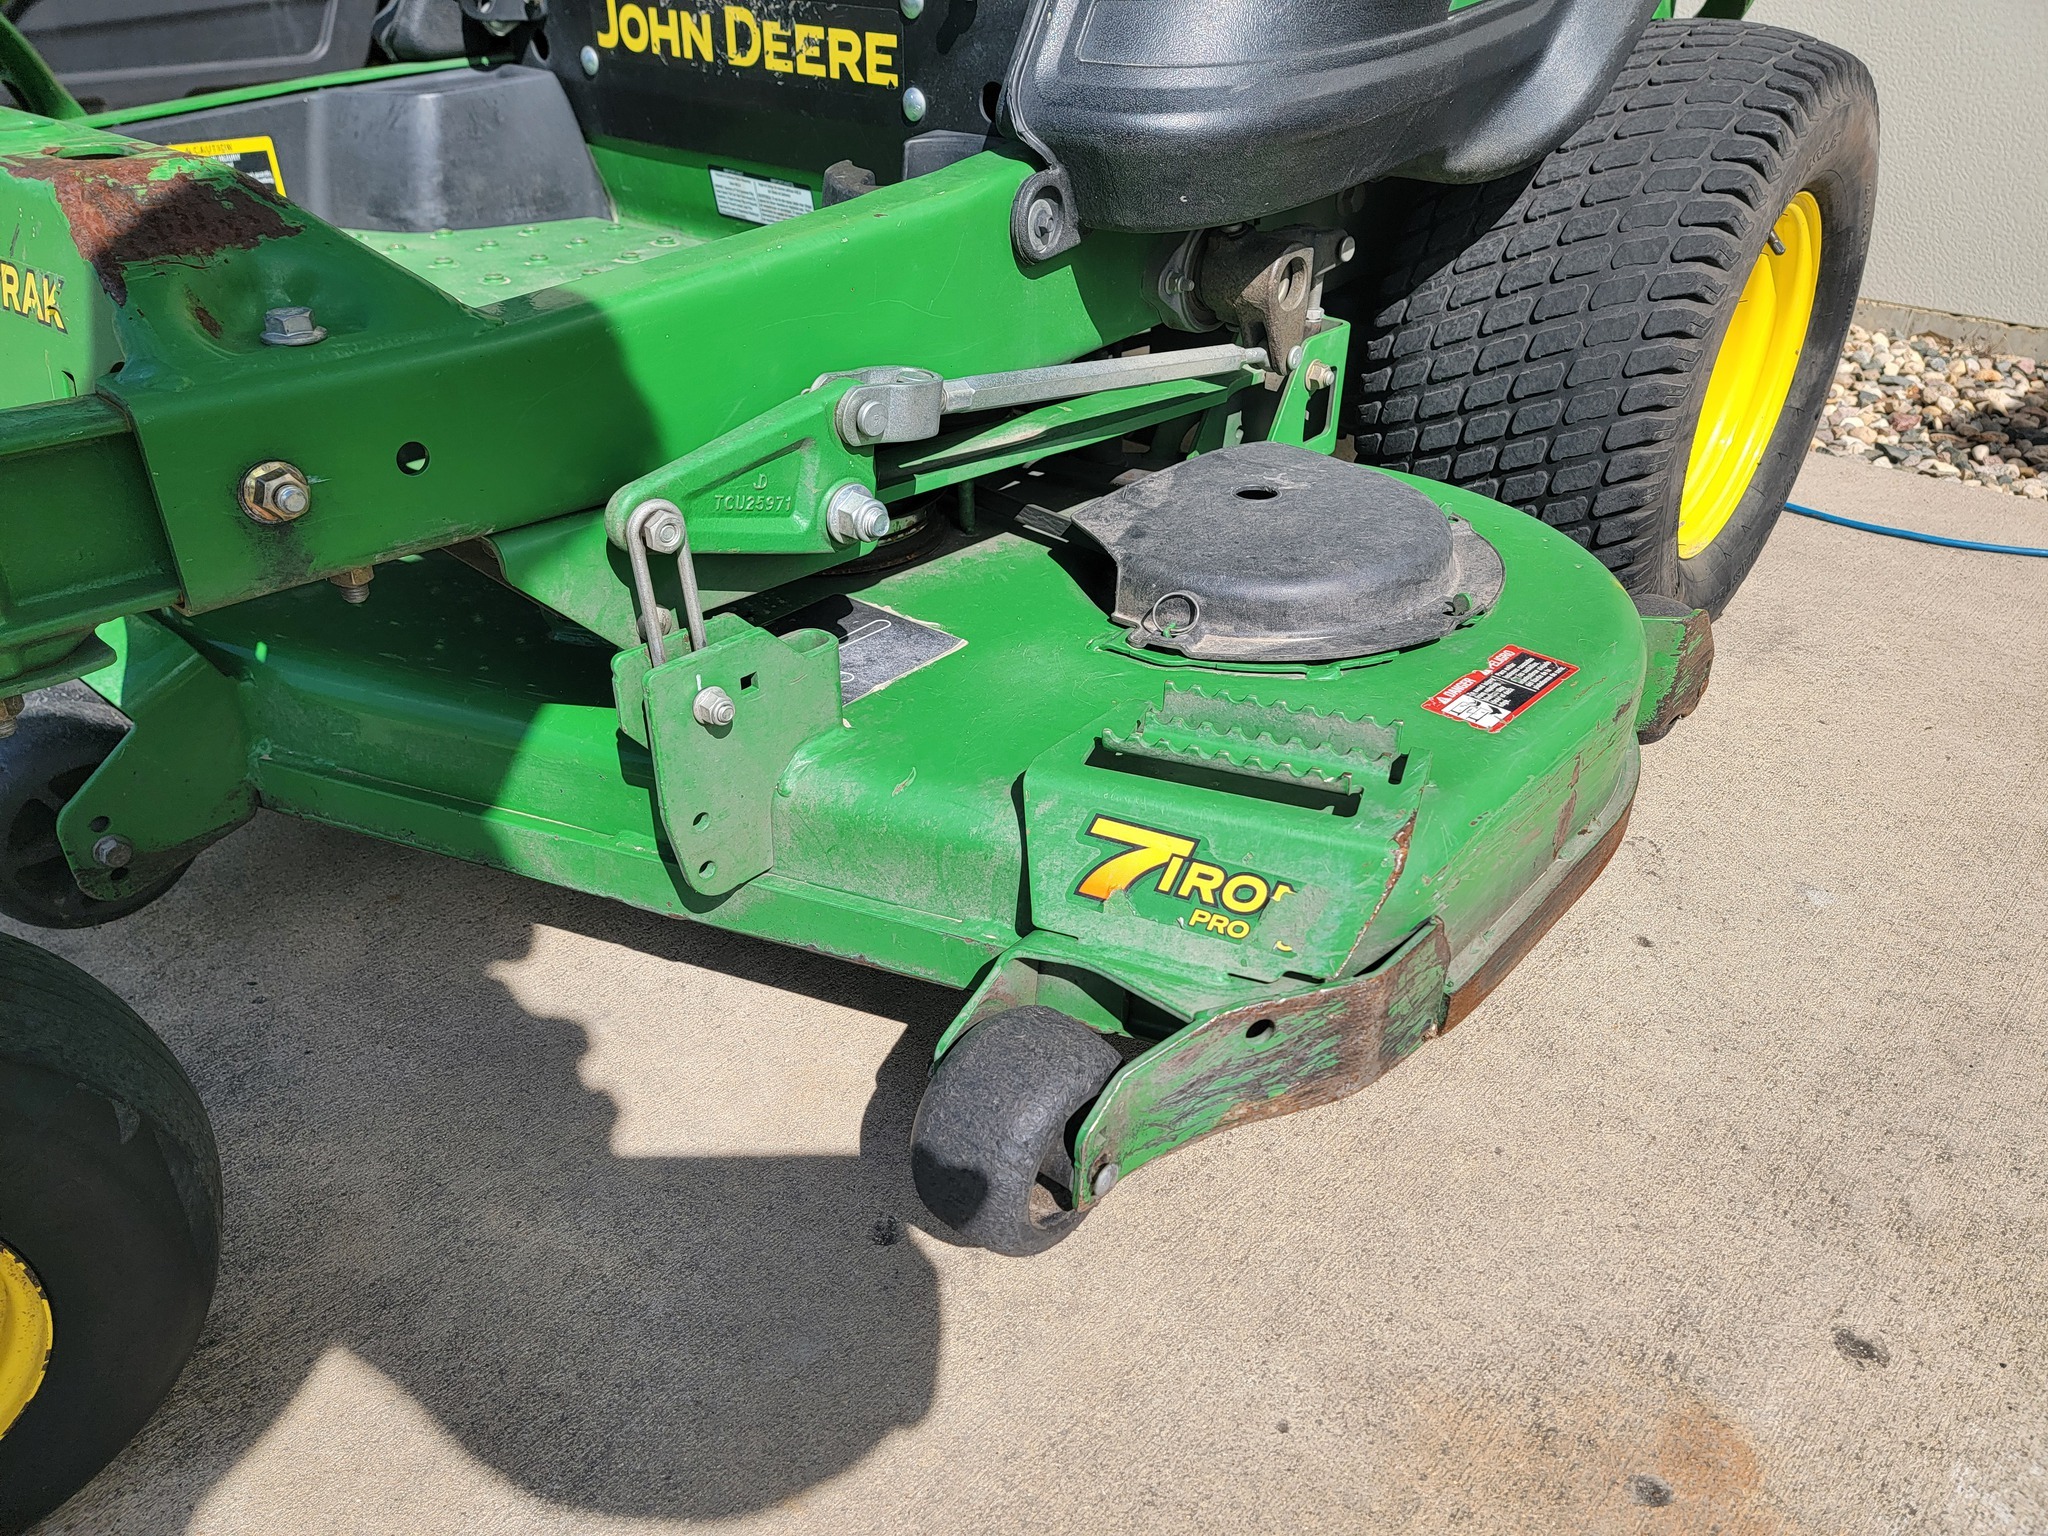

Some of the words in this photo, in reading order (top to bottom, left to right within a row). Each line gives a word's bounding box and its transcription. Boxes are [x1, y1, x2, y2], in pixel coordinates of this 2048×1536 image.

[597, 0, 714, 62] JOHN
[724, 5, 899, 87] DEERE
[714, 494, 792, 512] TCU25971
[1443, 677, 1477, 697] DANGER
[1188, 908, 1251, 939] PRO
